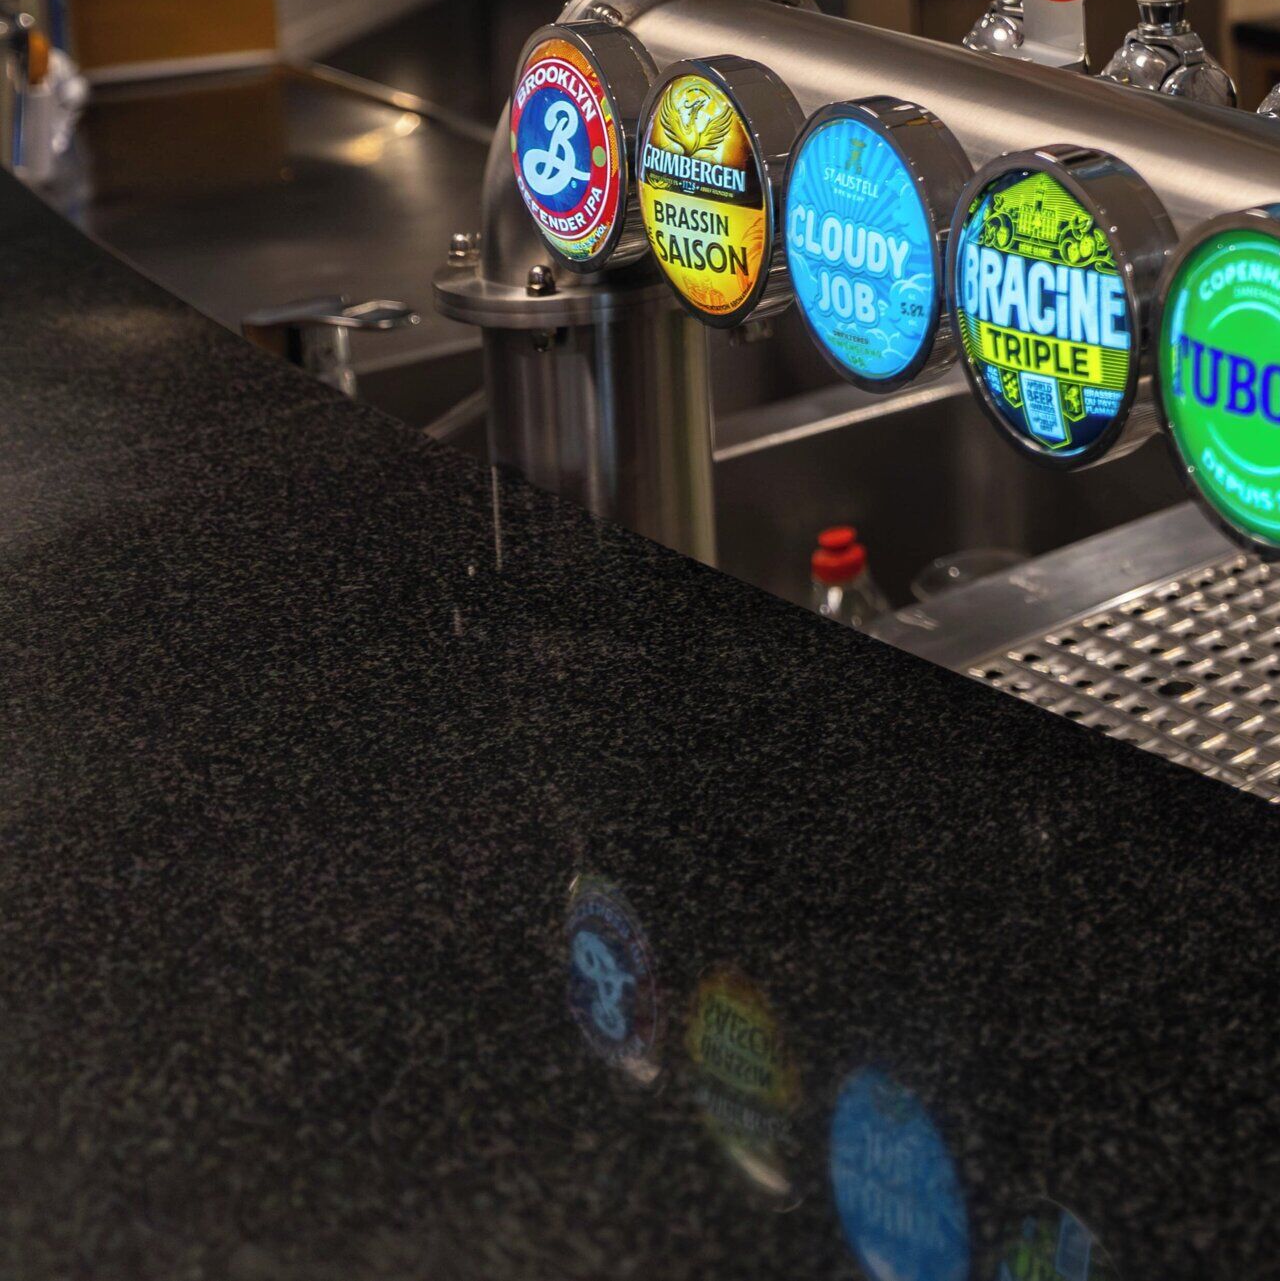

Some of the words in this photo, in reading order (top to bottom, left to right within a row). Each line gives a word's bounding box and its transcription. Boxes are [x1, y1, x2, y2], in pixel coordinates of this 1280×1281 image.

[516, 65, 597, 122] BROOKLYN
[643, 143, 746, 192] GRIMBERGEN
[834, 172, 879, 199] AUSTELL
[517, 174, 586, 232] DEFENDER
[584, 187, 604, 217] IPA
[653, 199, 729, 237] BRASSIN
[655, 229, 750, 277] SAISON
[790, 204, 909, 280] CLOUDY
[818, 269, 876, 324] JOB
[987, 326, 1090, 377] TRIPLE
[1027, 389, 1053, 404] BEER
[1201, 447, 1274, 511] DEPUIS
